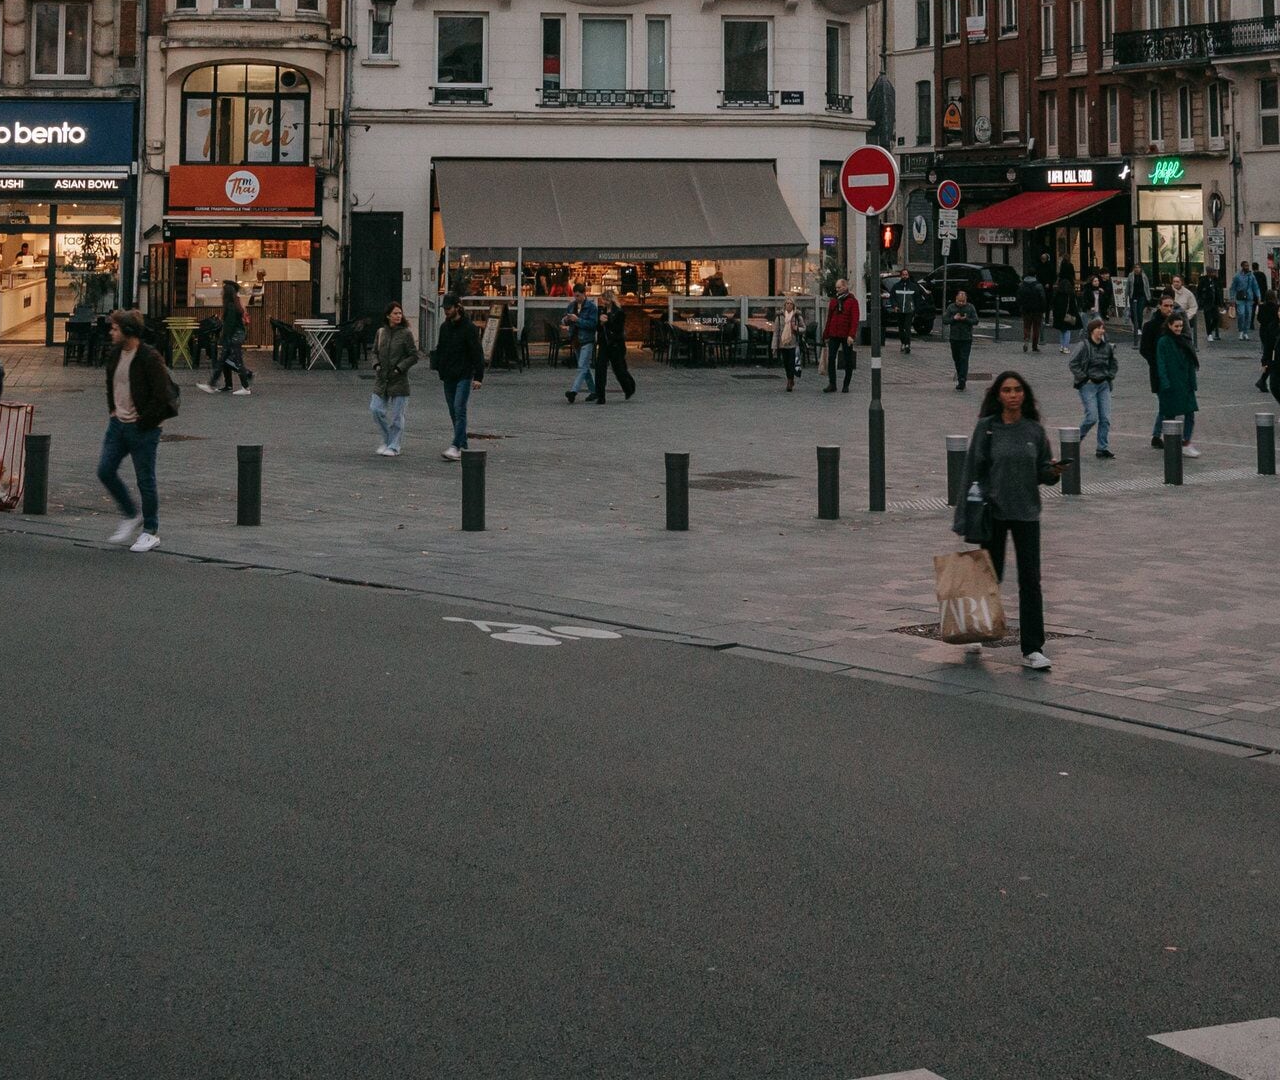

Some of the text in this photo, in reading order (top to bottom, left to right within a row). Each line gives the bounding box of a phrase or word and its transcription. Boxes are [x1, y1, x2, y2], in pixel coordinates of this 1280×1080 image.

[14, 121, 86, 144] bento
[54, 179, 118, 189] ASIAN BOWL
